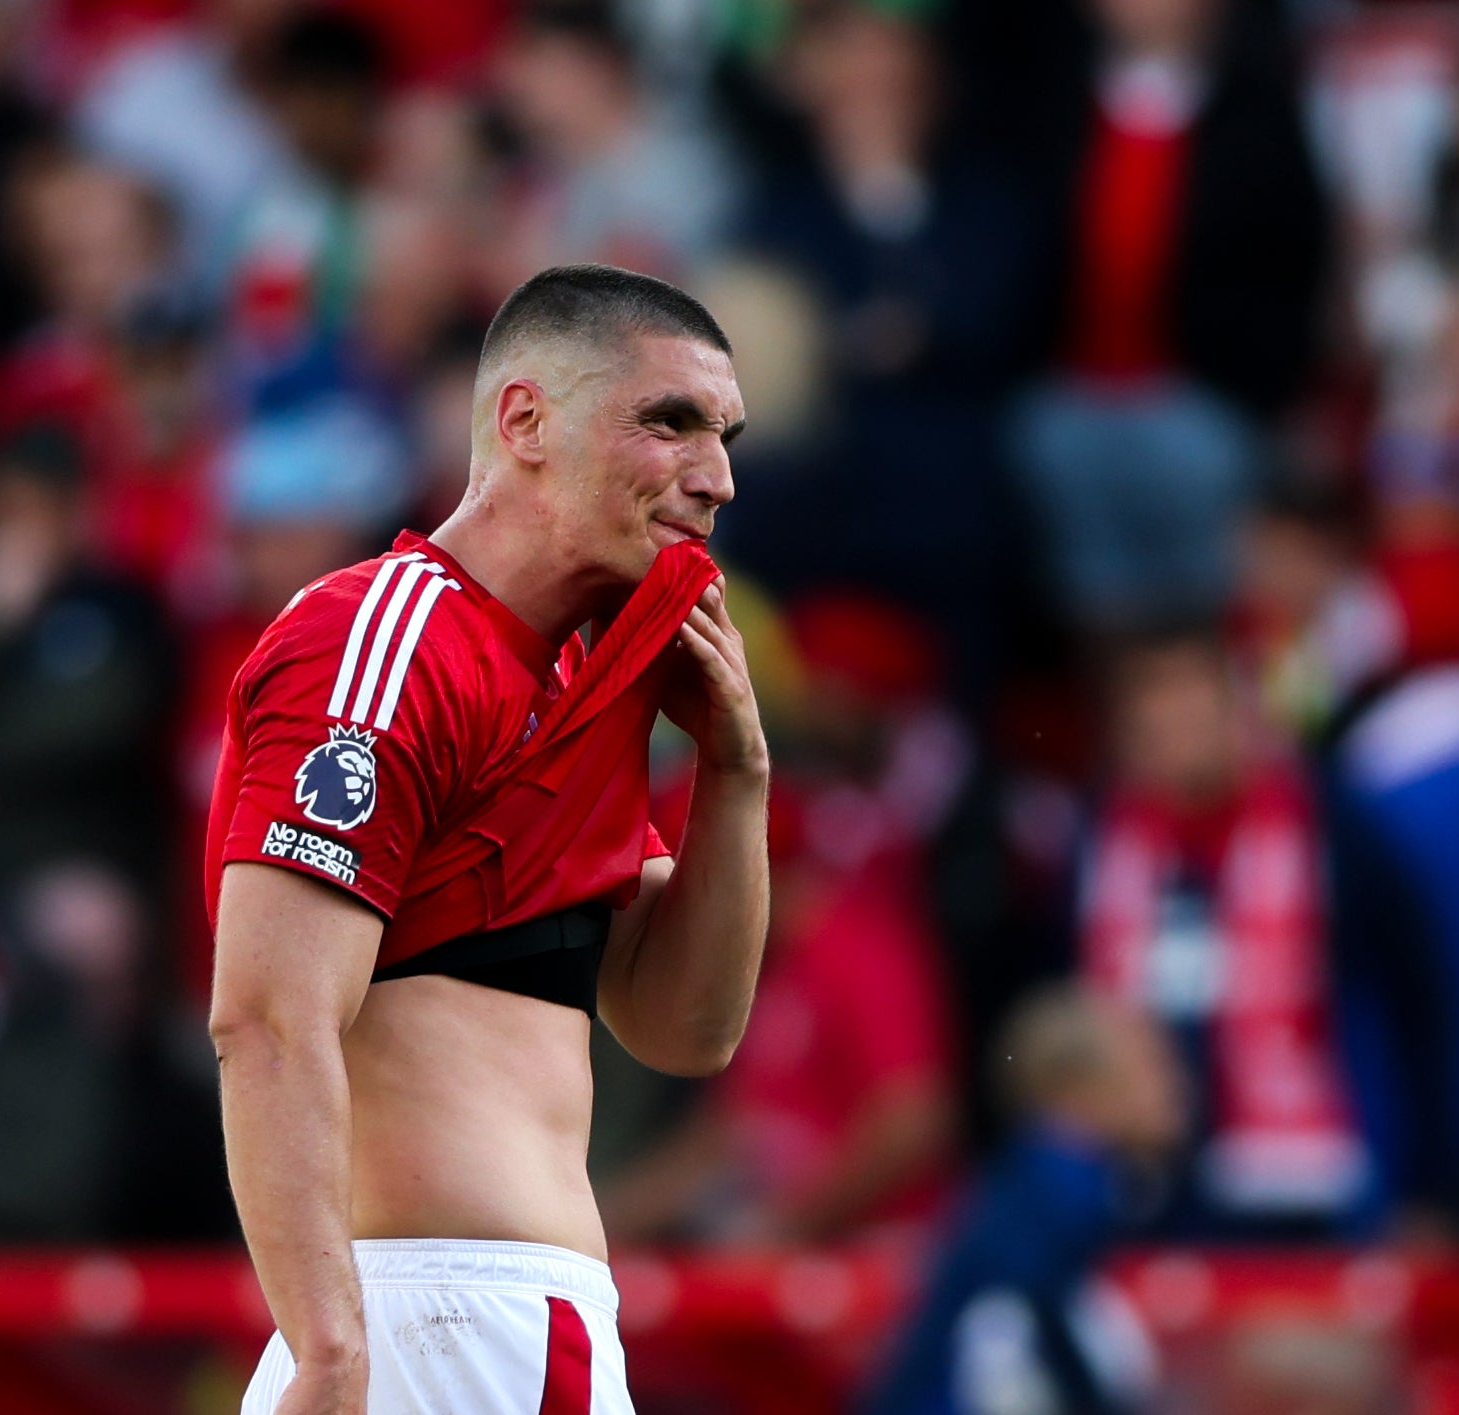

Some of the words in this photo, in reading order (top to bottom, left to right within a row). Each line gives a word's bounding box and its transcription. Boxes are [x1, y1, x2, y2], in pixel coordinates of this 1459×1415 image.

[261, 837, 293, 857] for
[291, 846, 356, 886] racism
[266, 821, 298, 843] No
[298, 832, 354, 867] room
